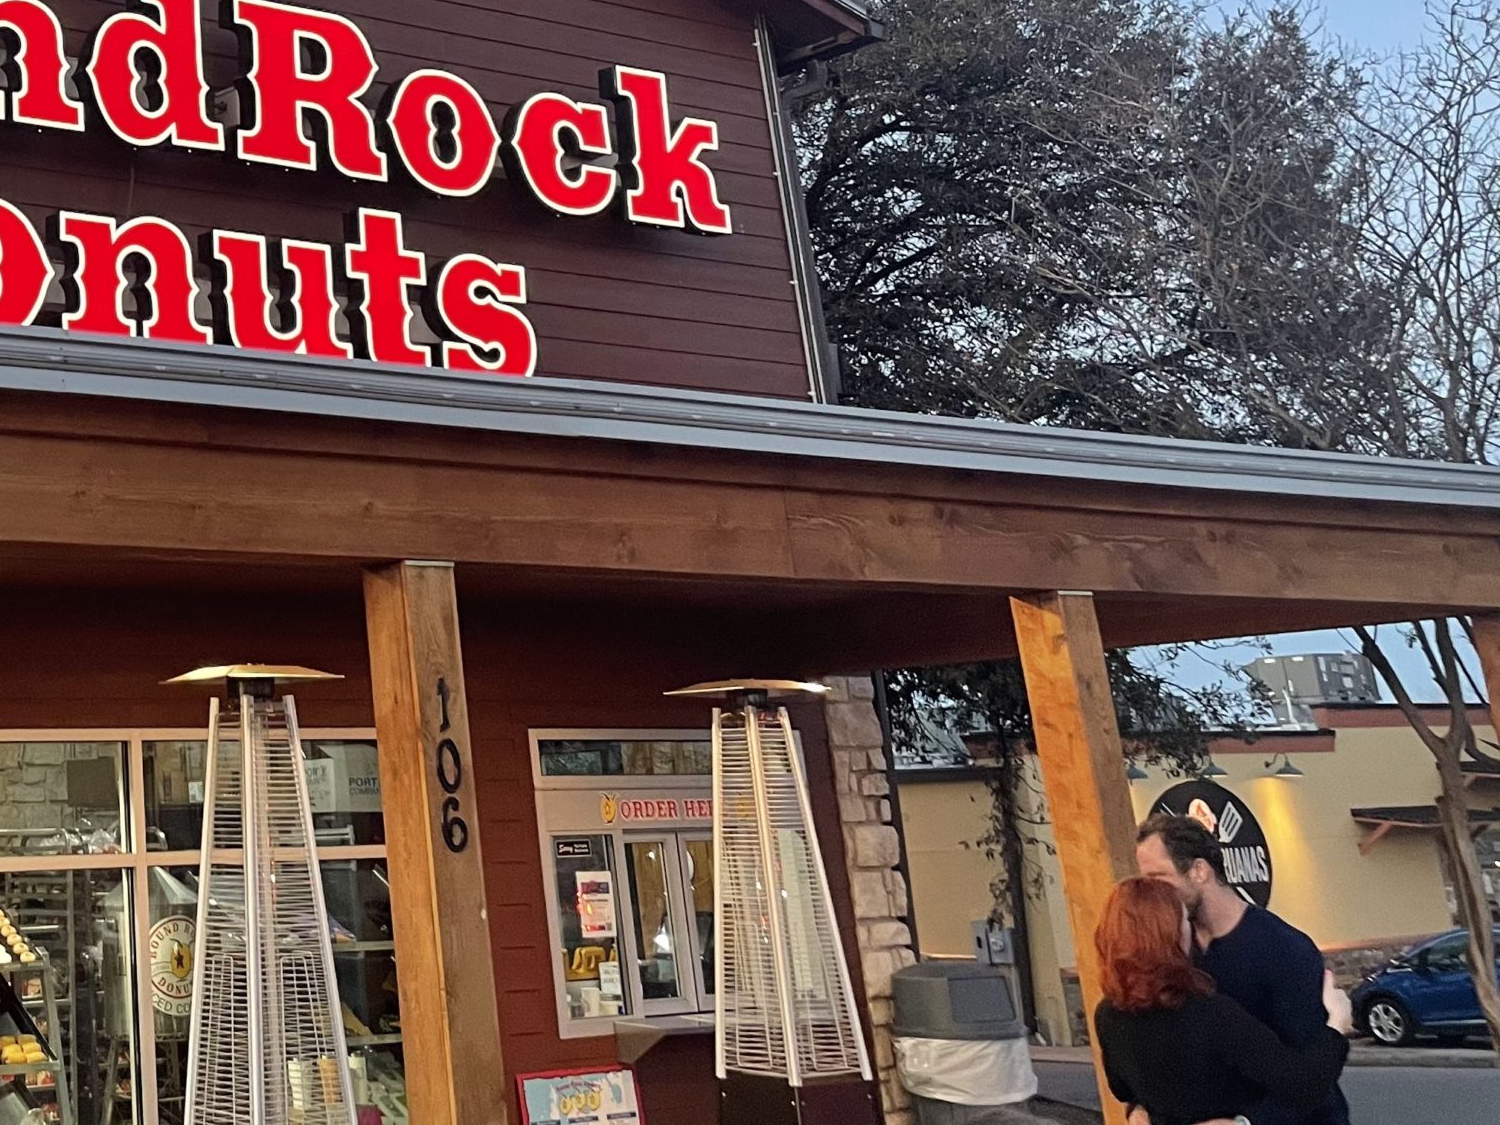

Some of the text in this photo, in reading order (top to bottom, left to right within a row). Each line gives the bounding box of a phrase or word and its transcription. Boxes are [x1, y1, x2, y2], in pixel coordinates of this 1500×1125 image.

[436, 676, 468, 853] 106
[620, 799, 713, 820] ORDER HE
[158, 977, 192, 995] DONU
[152, 993, 173, 1011] CED
